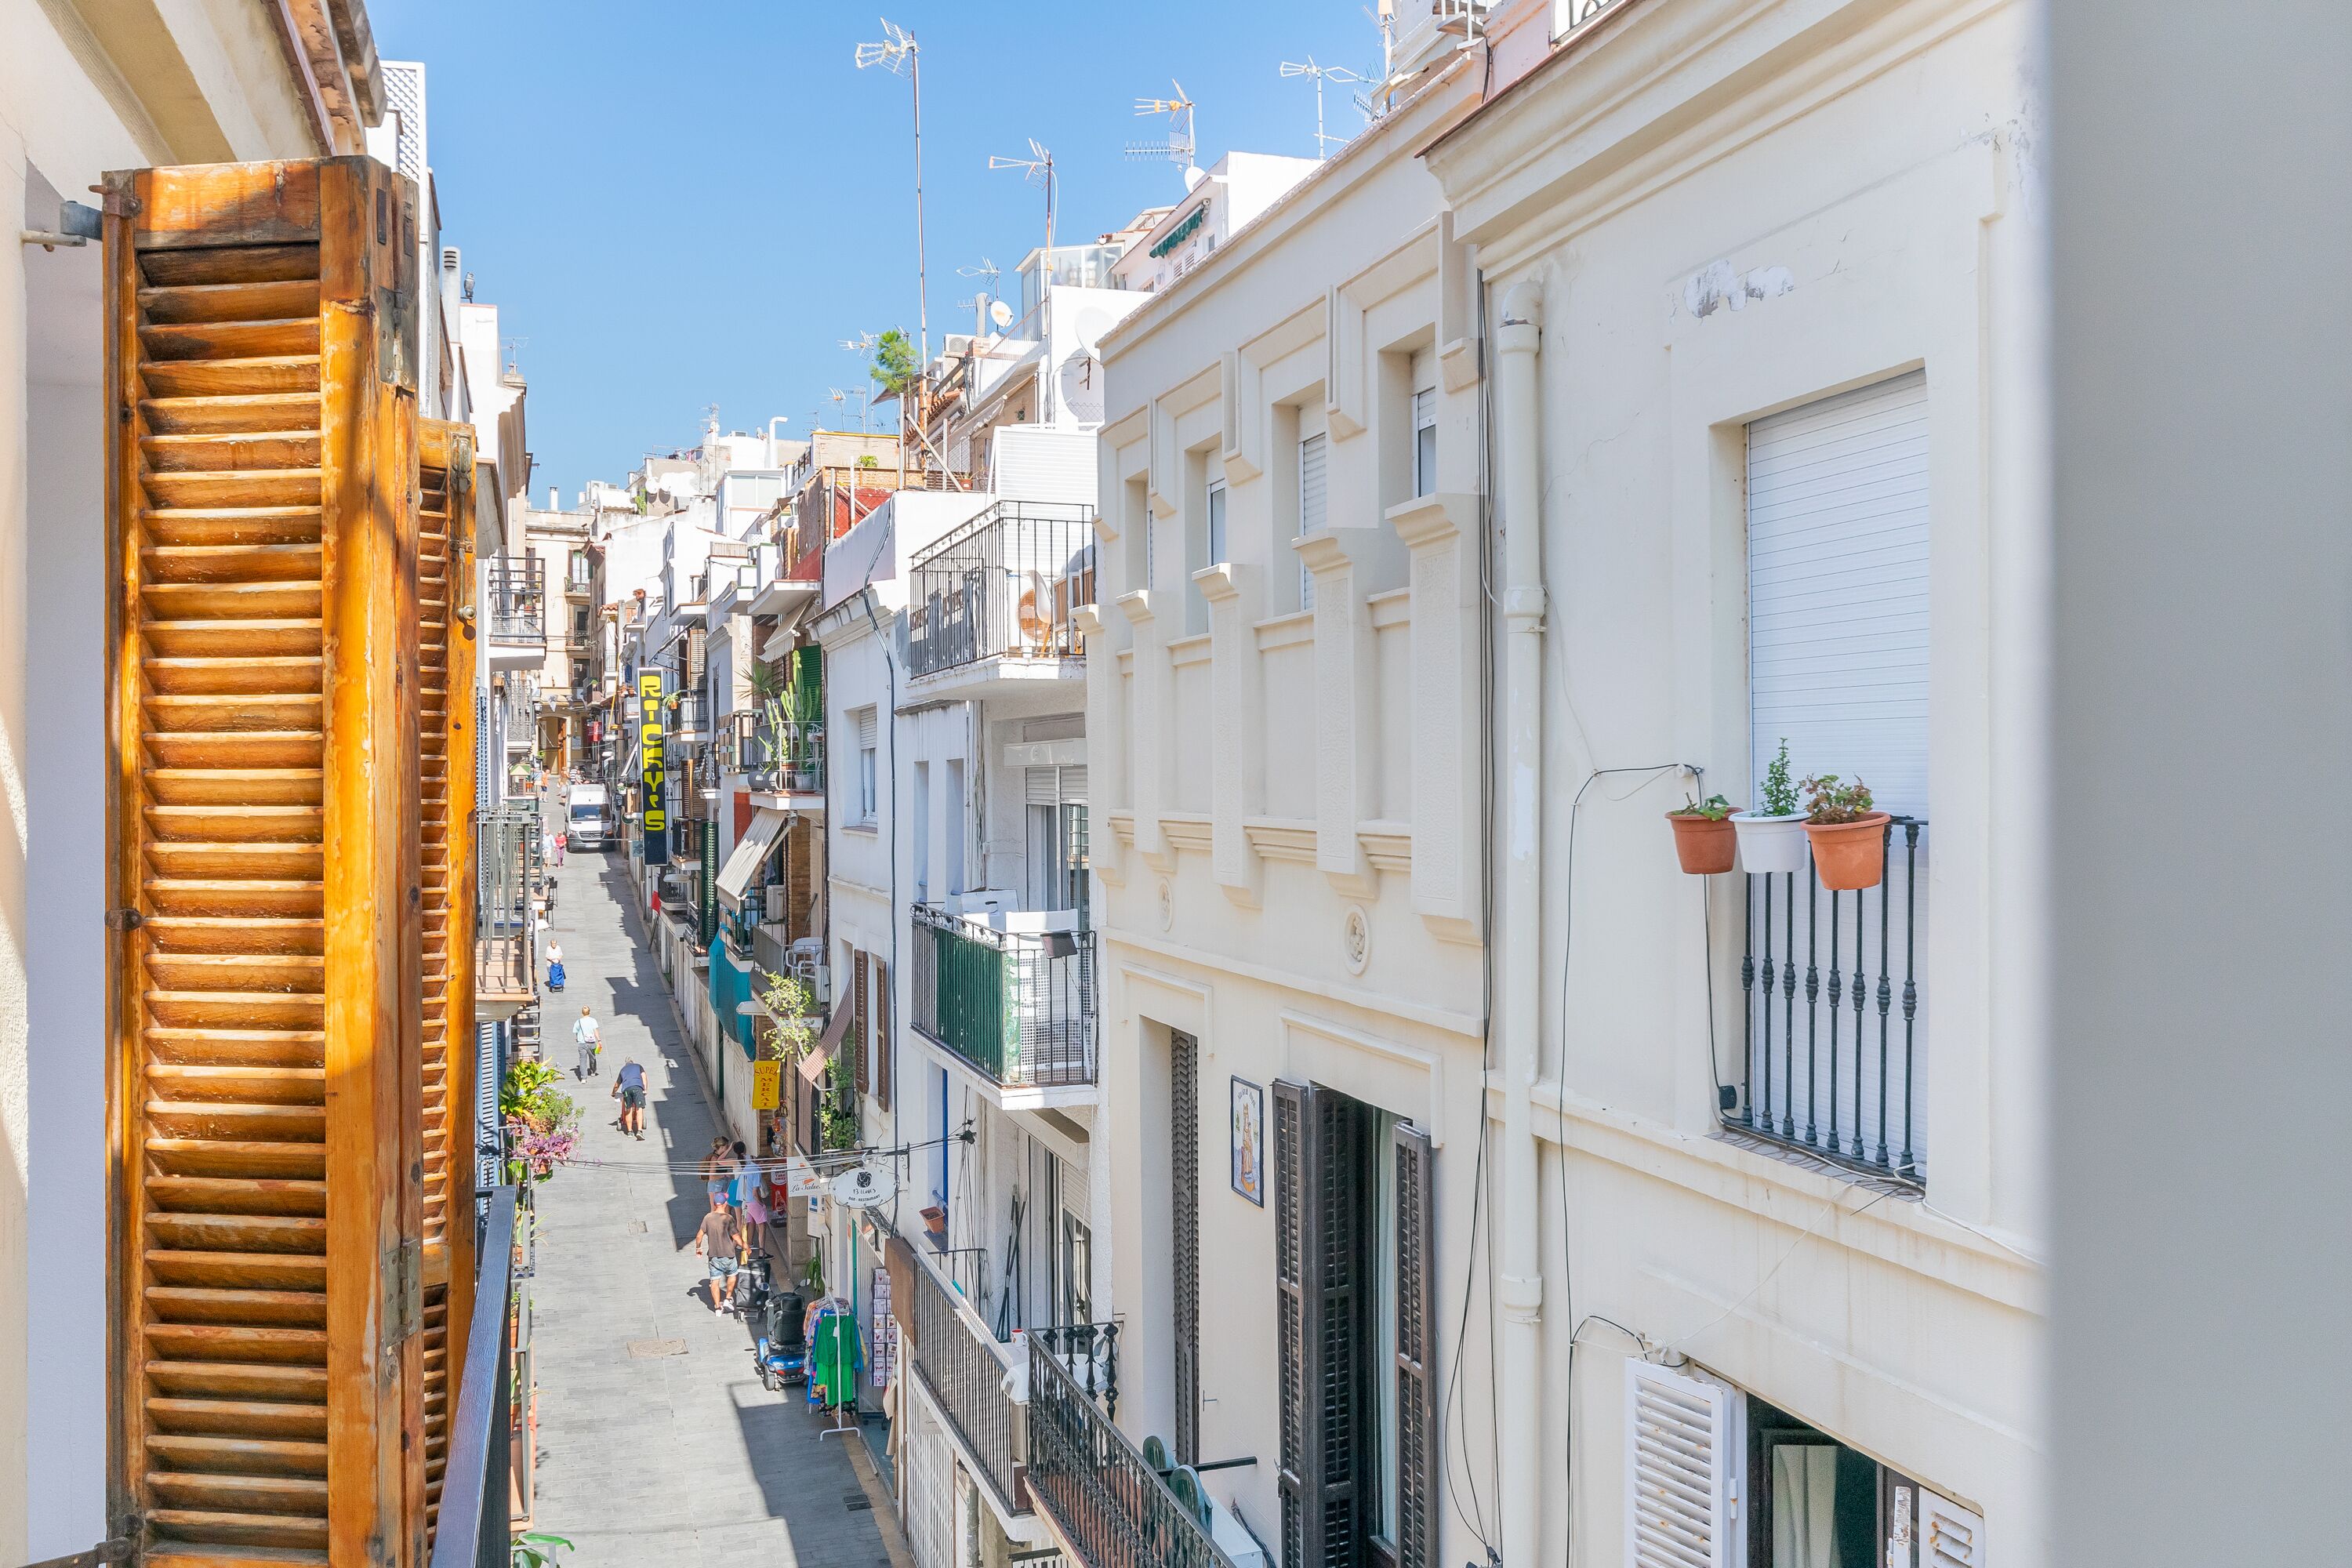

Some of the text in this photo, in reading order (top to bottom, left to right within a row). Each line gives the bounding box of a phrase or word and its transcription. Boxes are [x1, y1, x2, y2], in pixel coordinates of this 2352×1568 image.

[641, 675, 666, 831] RICKY'S
[760, 1078, 772, 1106] MERCAT
[789, 1183, 800, 1192] La
